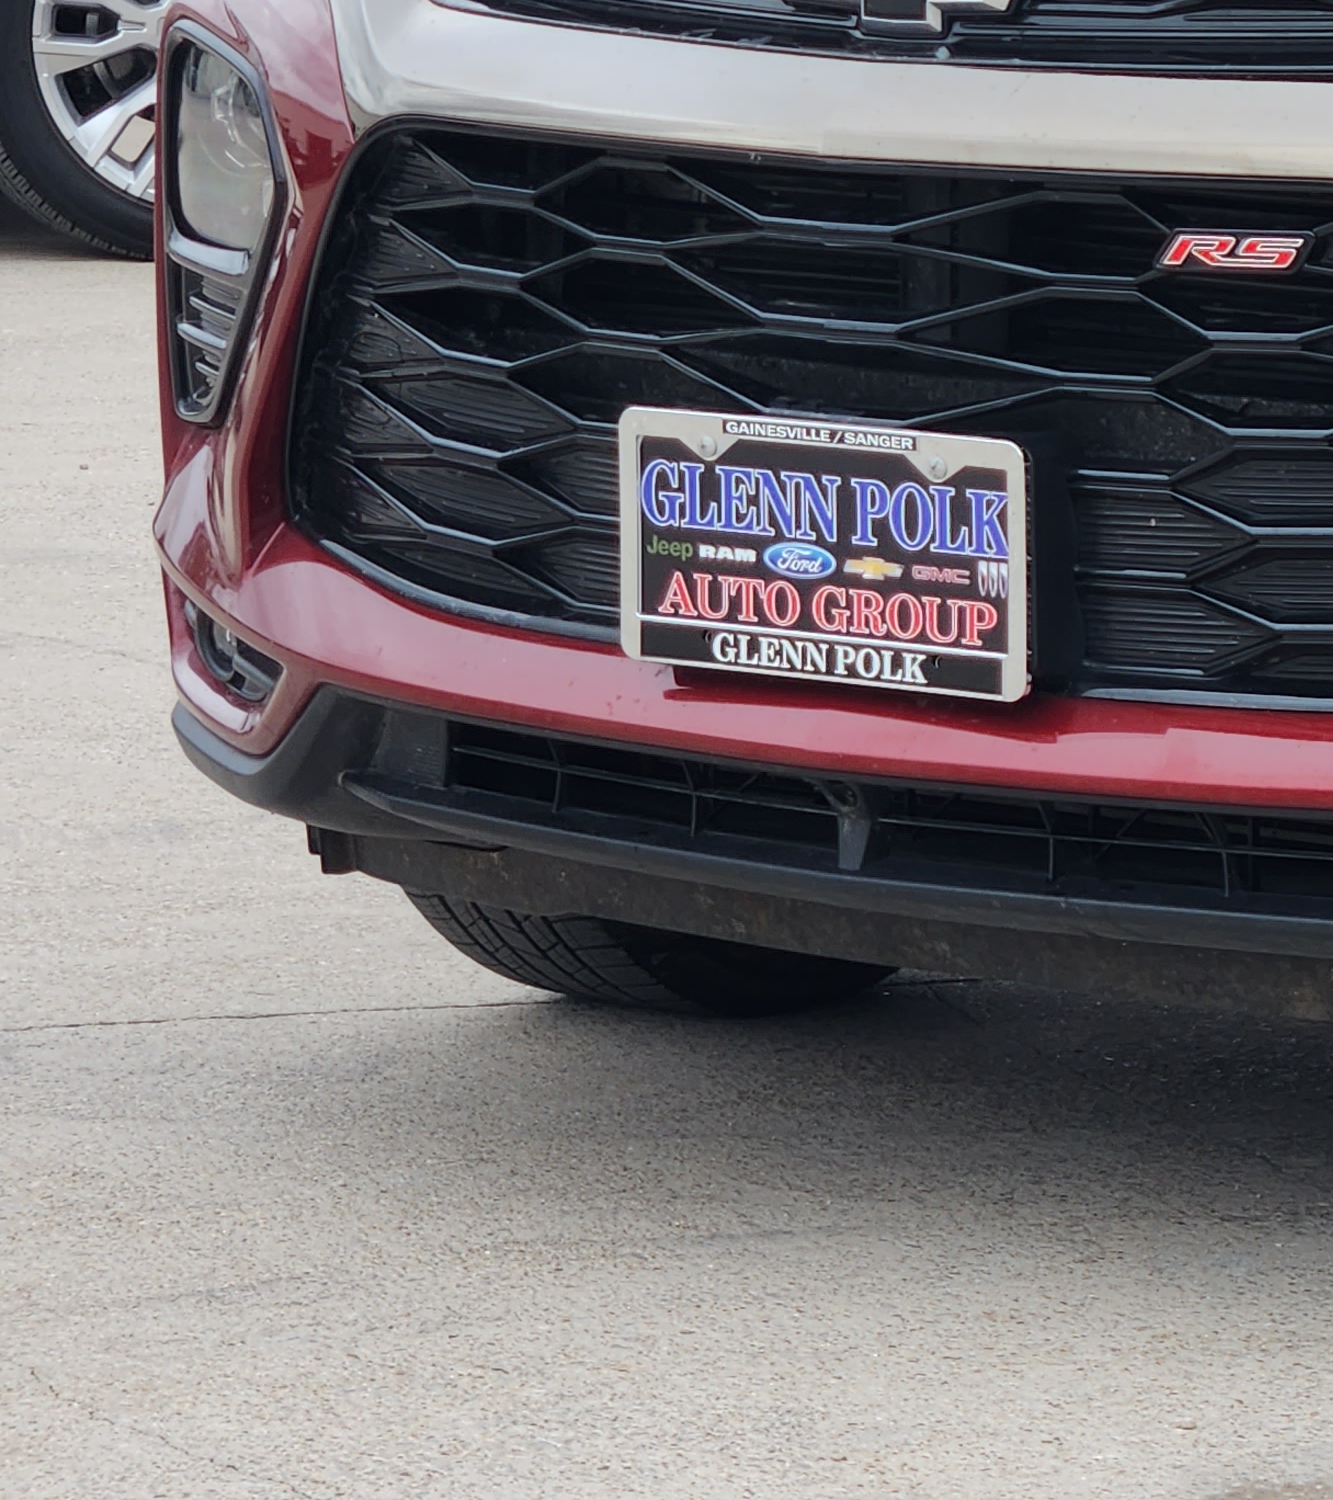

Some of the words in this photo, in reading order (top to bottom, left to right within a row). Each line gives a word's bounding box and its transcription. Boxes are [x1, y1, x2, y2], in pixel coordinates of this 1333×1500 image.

[1160, 234, 1304, 268] RS
[725, 420, 831, 444] GAINESVILLE
[843, 431, 914, 451] SANGER
[641, 458, 841, 543] GLENN
[851, 478, 1009, 559] POLK
[646, 535, 693, 561] Jeep
[699, 544, 757, 562] RAM
[777, 546, 823, 573] Ford
[911, 565, 971, 585] GMC
[657, 570, 801, 628] AUTO
[812, 584, 998, 647] GROUP
[712, 631, 831, 675] GLENN
[833, 648, 929, 685] POLK
